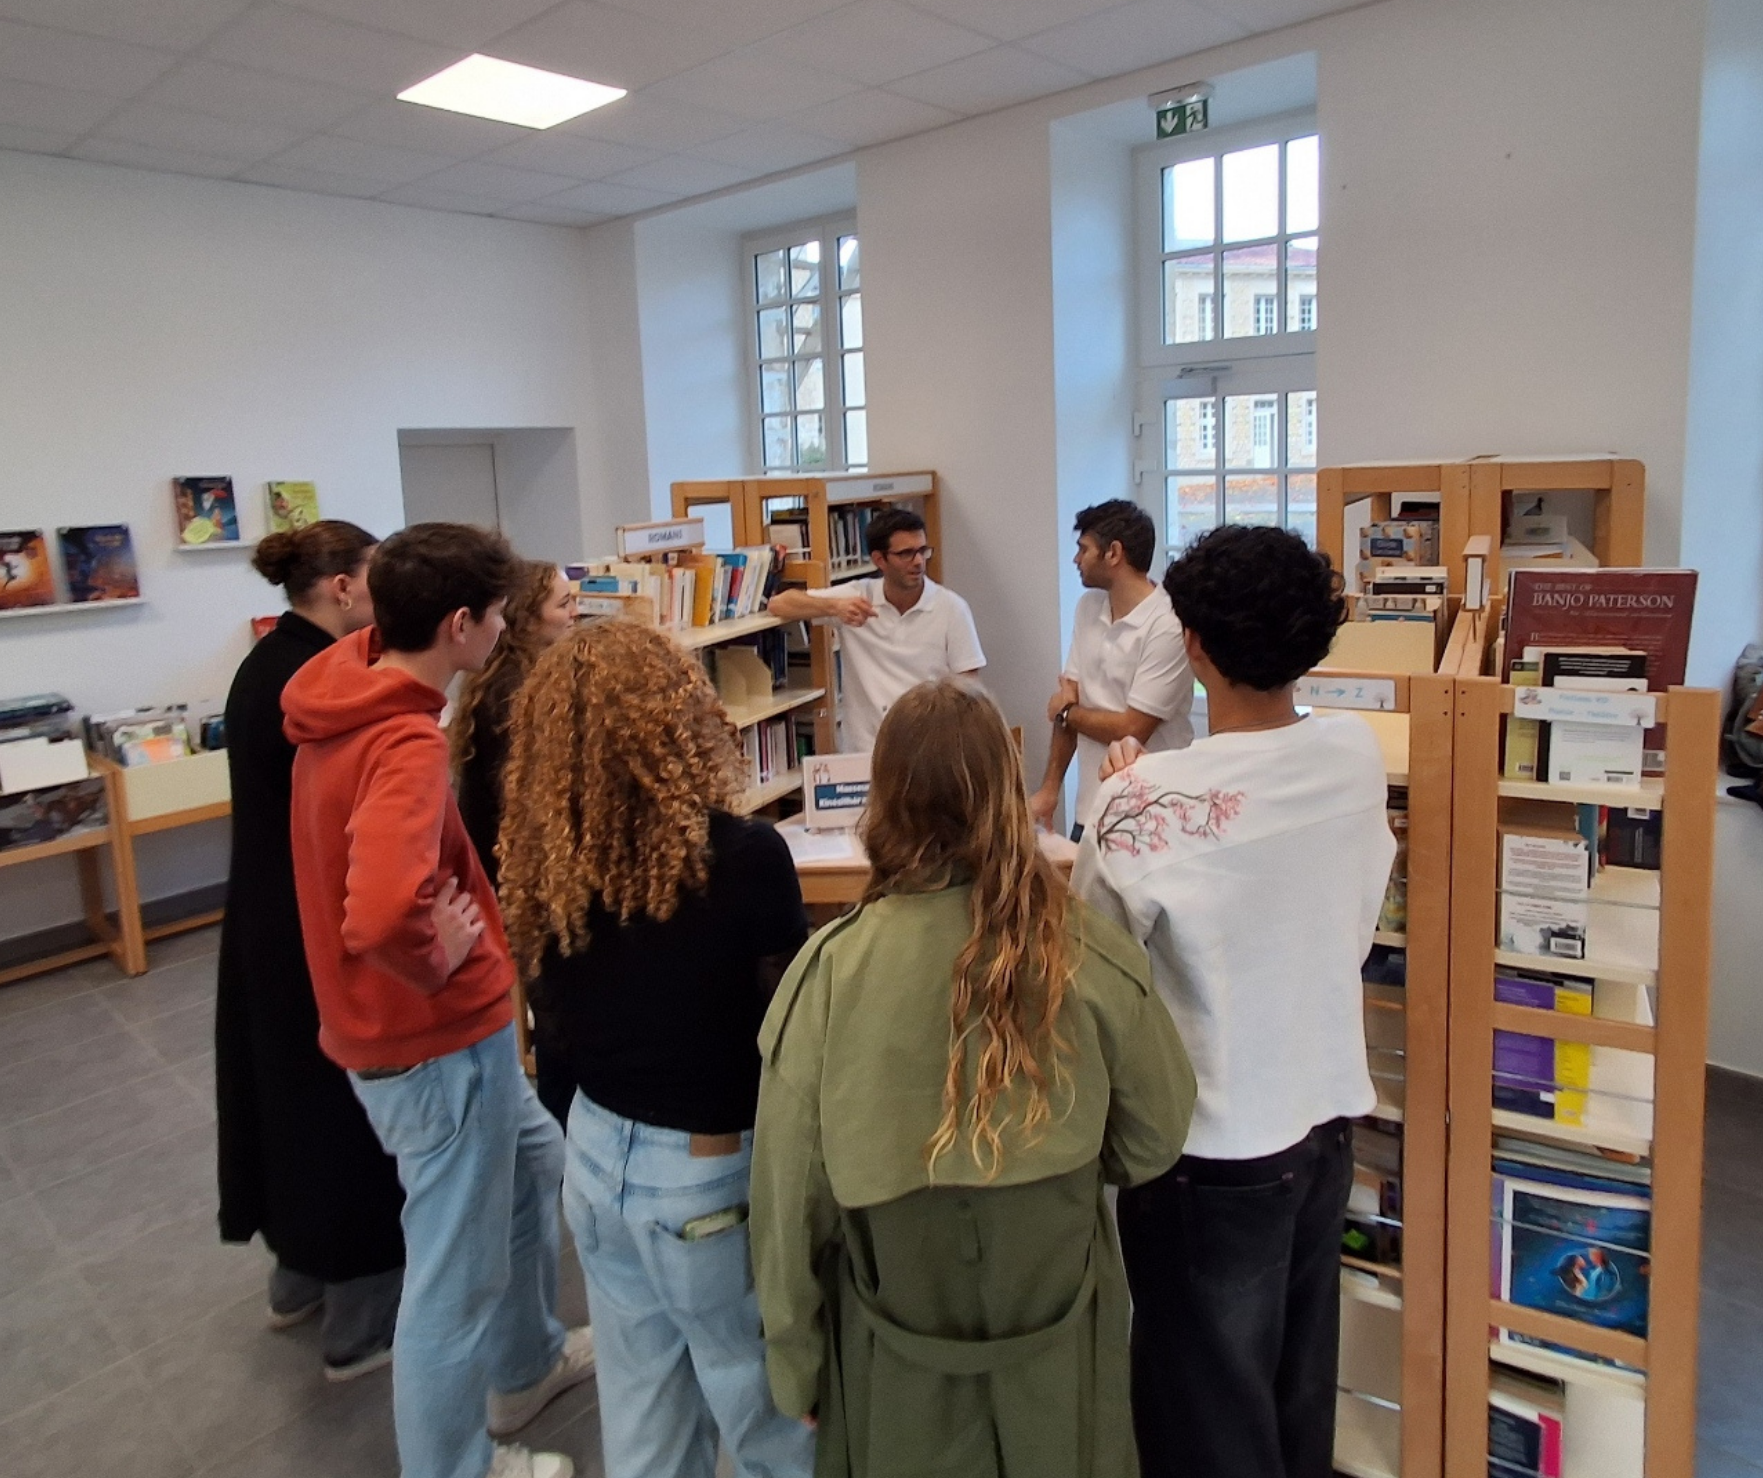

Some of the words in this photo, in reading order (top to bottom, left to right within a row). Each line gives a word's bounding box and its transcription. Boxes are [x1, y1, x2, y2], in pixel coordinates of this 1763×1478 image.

[1532, 593, 1584, 610] BANJO
[1588, 594, 1675, 609] PATERSON
[1355, 687, 1363, 698] Z
[836, 783, 870, 794] Masseu
